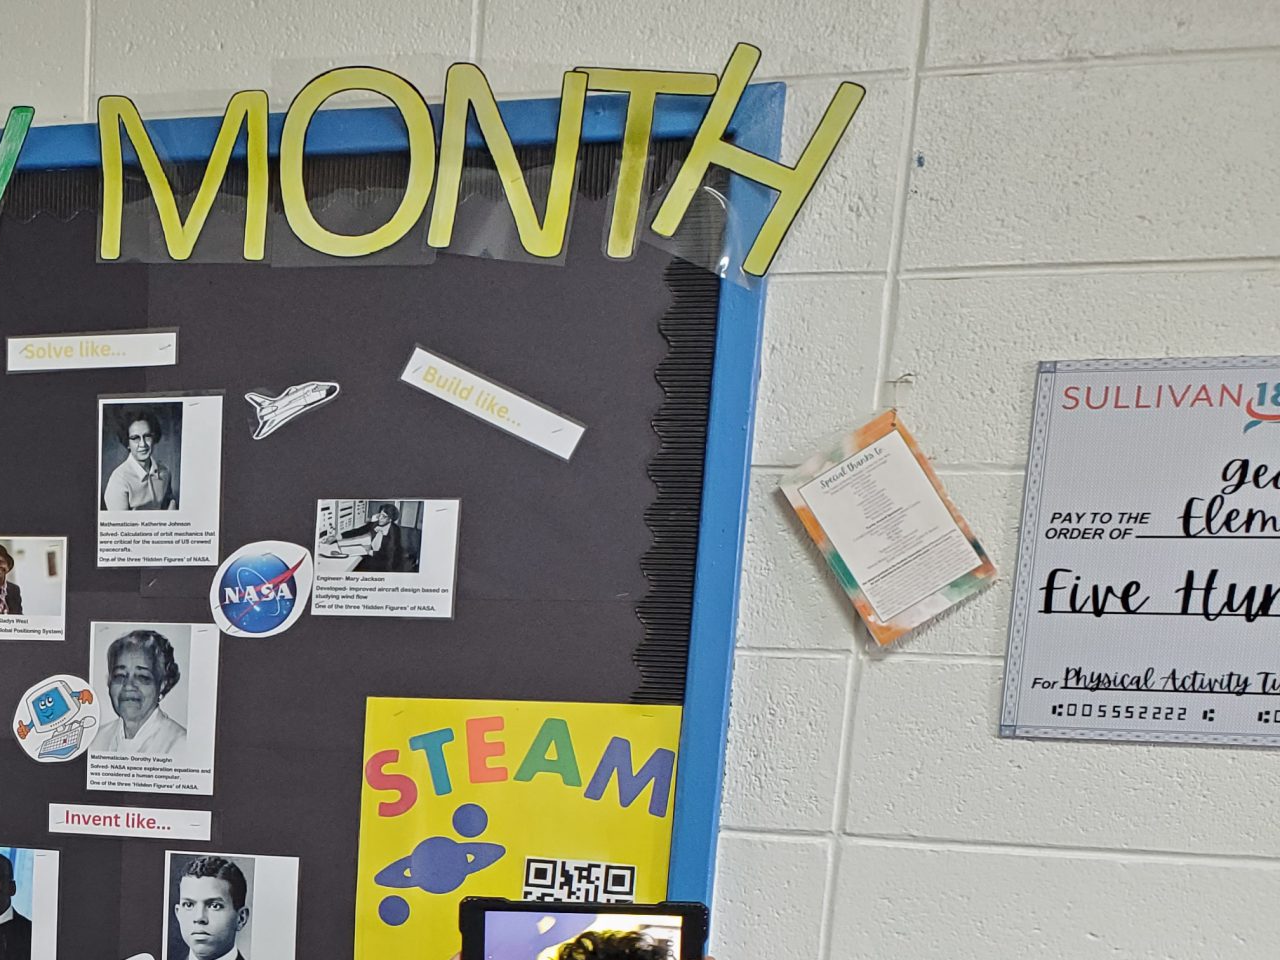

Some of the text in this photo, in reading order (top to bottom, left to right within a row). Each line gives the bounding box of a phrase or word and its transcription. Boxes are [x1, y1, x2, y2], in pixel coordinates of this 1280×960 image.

[96, 41, 866, 277] MONTH
[25, 343, 73, 359] Solve
[423, 365, 474, 400] Build
[1062, 383, 1243, 410] SULLIVAN
[820, 466, 846, 489] Special
[847, 453, 874, 471] thanks
[1050, 512, 1086, 524] PAY
[1090, 513, 1112, 524] TO
[1117, 513, 1151, 524] THE
[1045, 528, 1133, 540] ORDER OF
[224, 583, 293, 604] NASA
[1039, 568, 1150, 617] Five
[1031, 678, 1059, 689] For
[1062, 666, 1155, 692] Physical
[1160, 668, 1252, 696] Activity
[365, 716, 675, 818] STEAM
[66, 810, 171, 830] Invent like...
